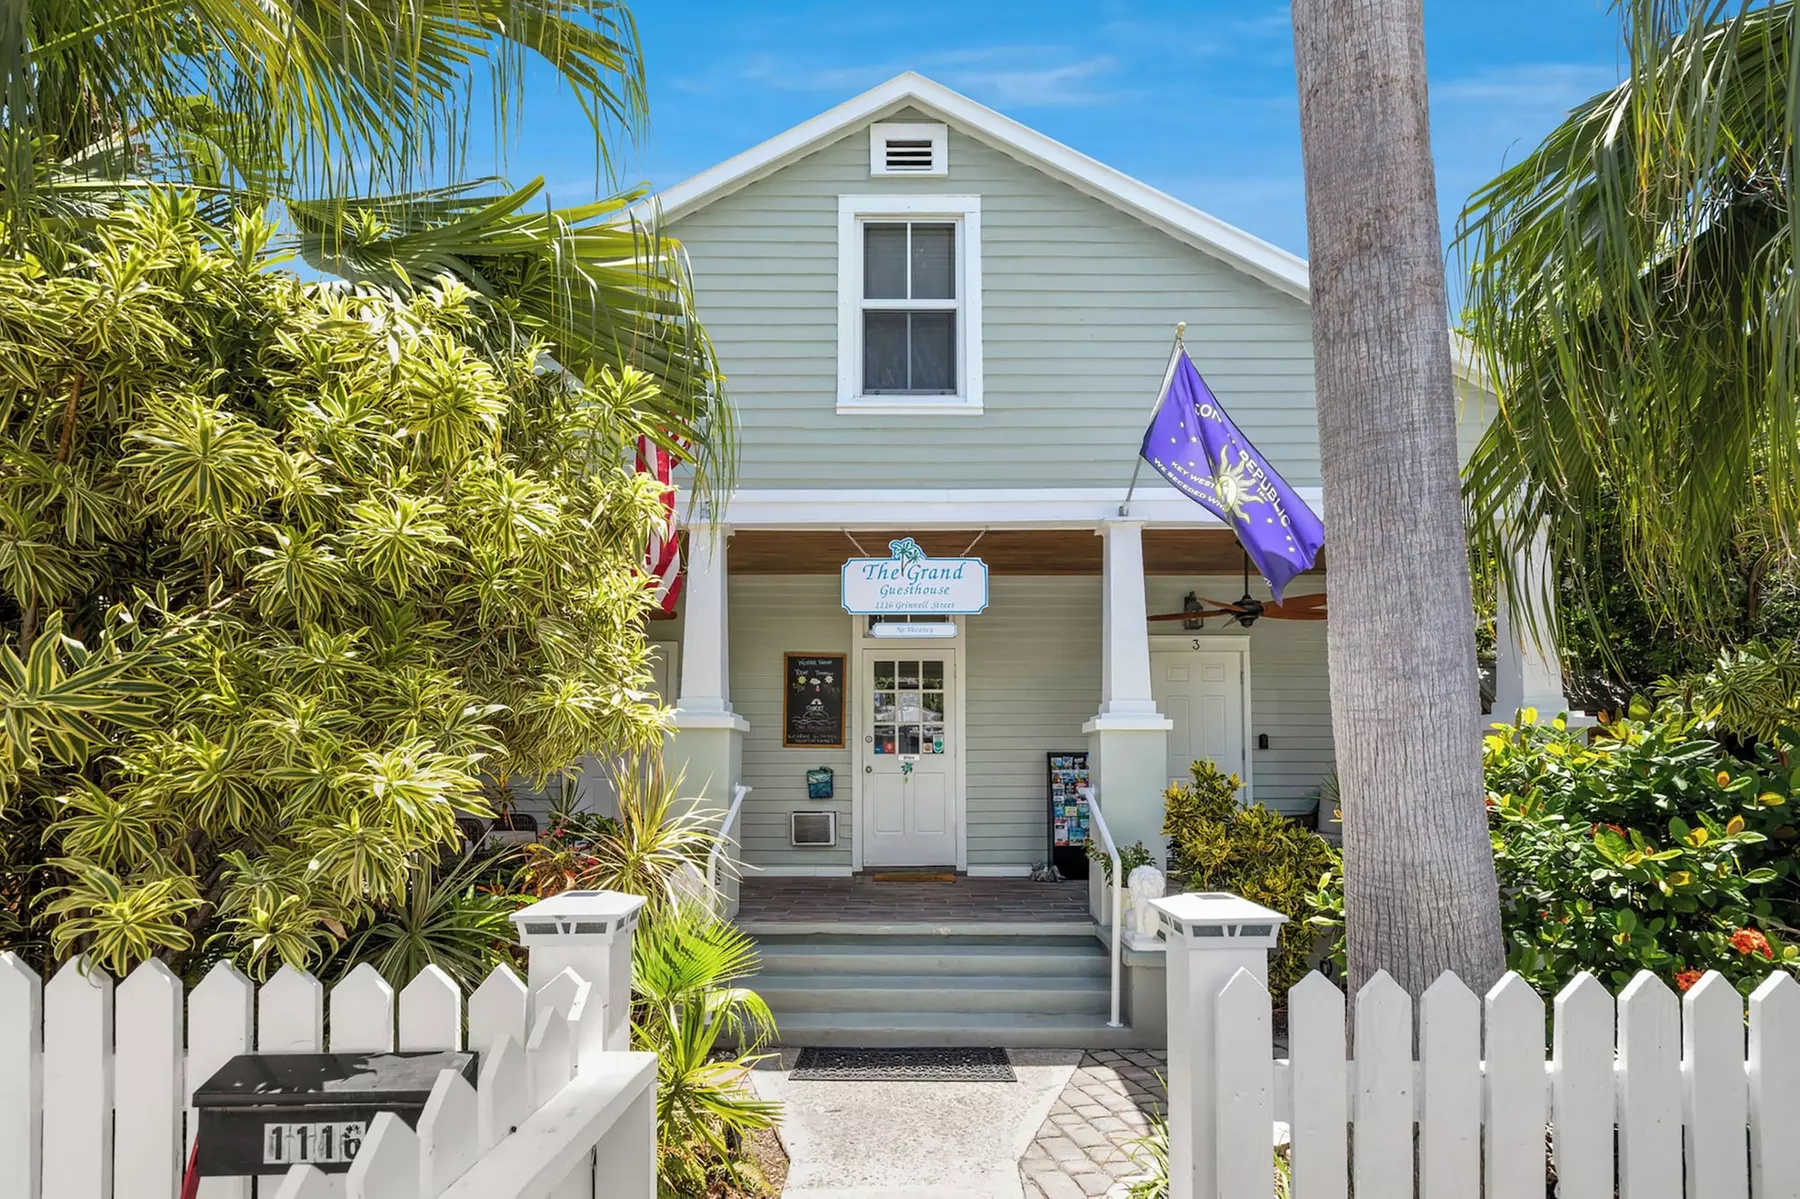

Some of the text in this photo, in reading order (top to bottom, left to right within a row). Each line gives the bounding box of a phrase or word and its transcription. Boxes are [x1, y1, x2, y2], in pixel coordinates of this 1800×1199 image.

[1154, 457, 1206, 499] WE SECEDED
[1171, 461, 1216, 489] KEY WEST
[1239, 449, 1291, 527] REPUBLIC
[862, 562, 967, 586] The Grand
[879, 584, 950, 599] Guesthouse
[875, 601, 955, 610] 1116 Grinnell Street
[1192, 639, 1200, 651] 3
